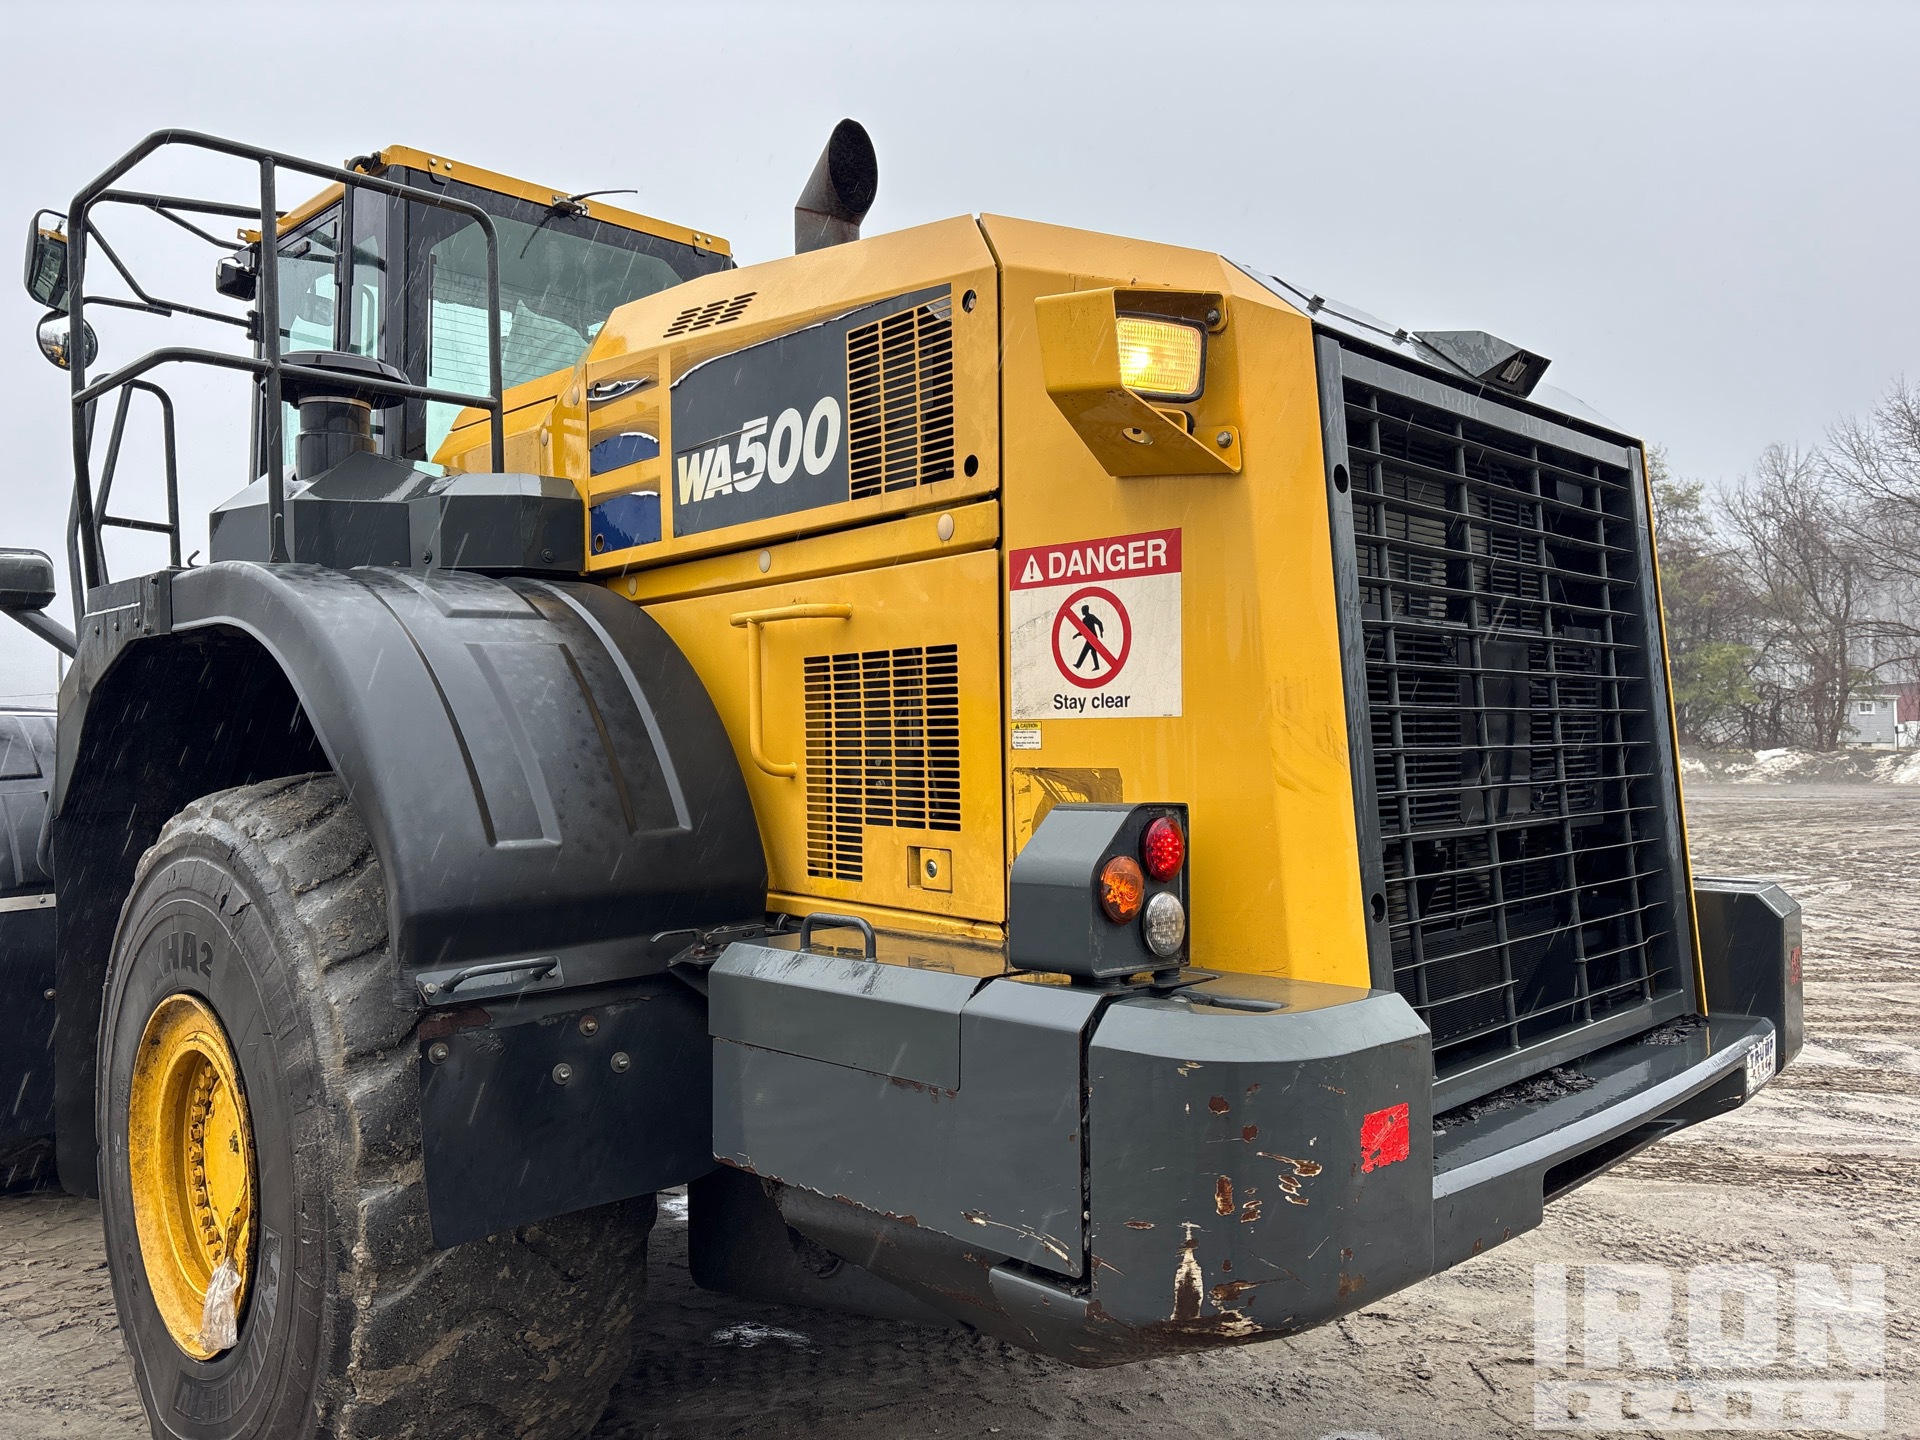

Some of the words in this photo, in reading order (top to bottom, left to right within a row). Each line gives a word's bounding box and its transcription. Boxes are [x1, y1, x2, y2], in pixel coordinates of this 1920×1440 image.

[677, 396, 842, 505] WA500
[1048, 538, 1168, 579] DANGER
[1053, 693, 1087, 713] Stay
[1091, 693, 1131, 709] clear
